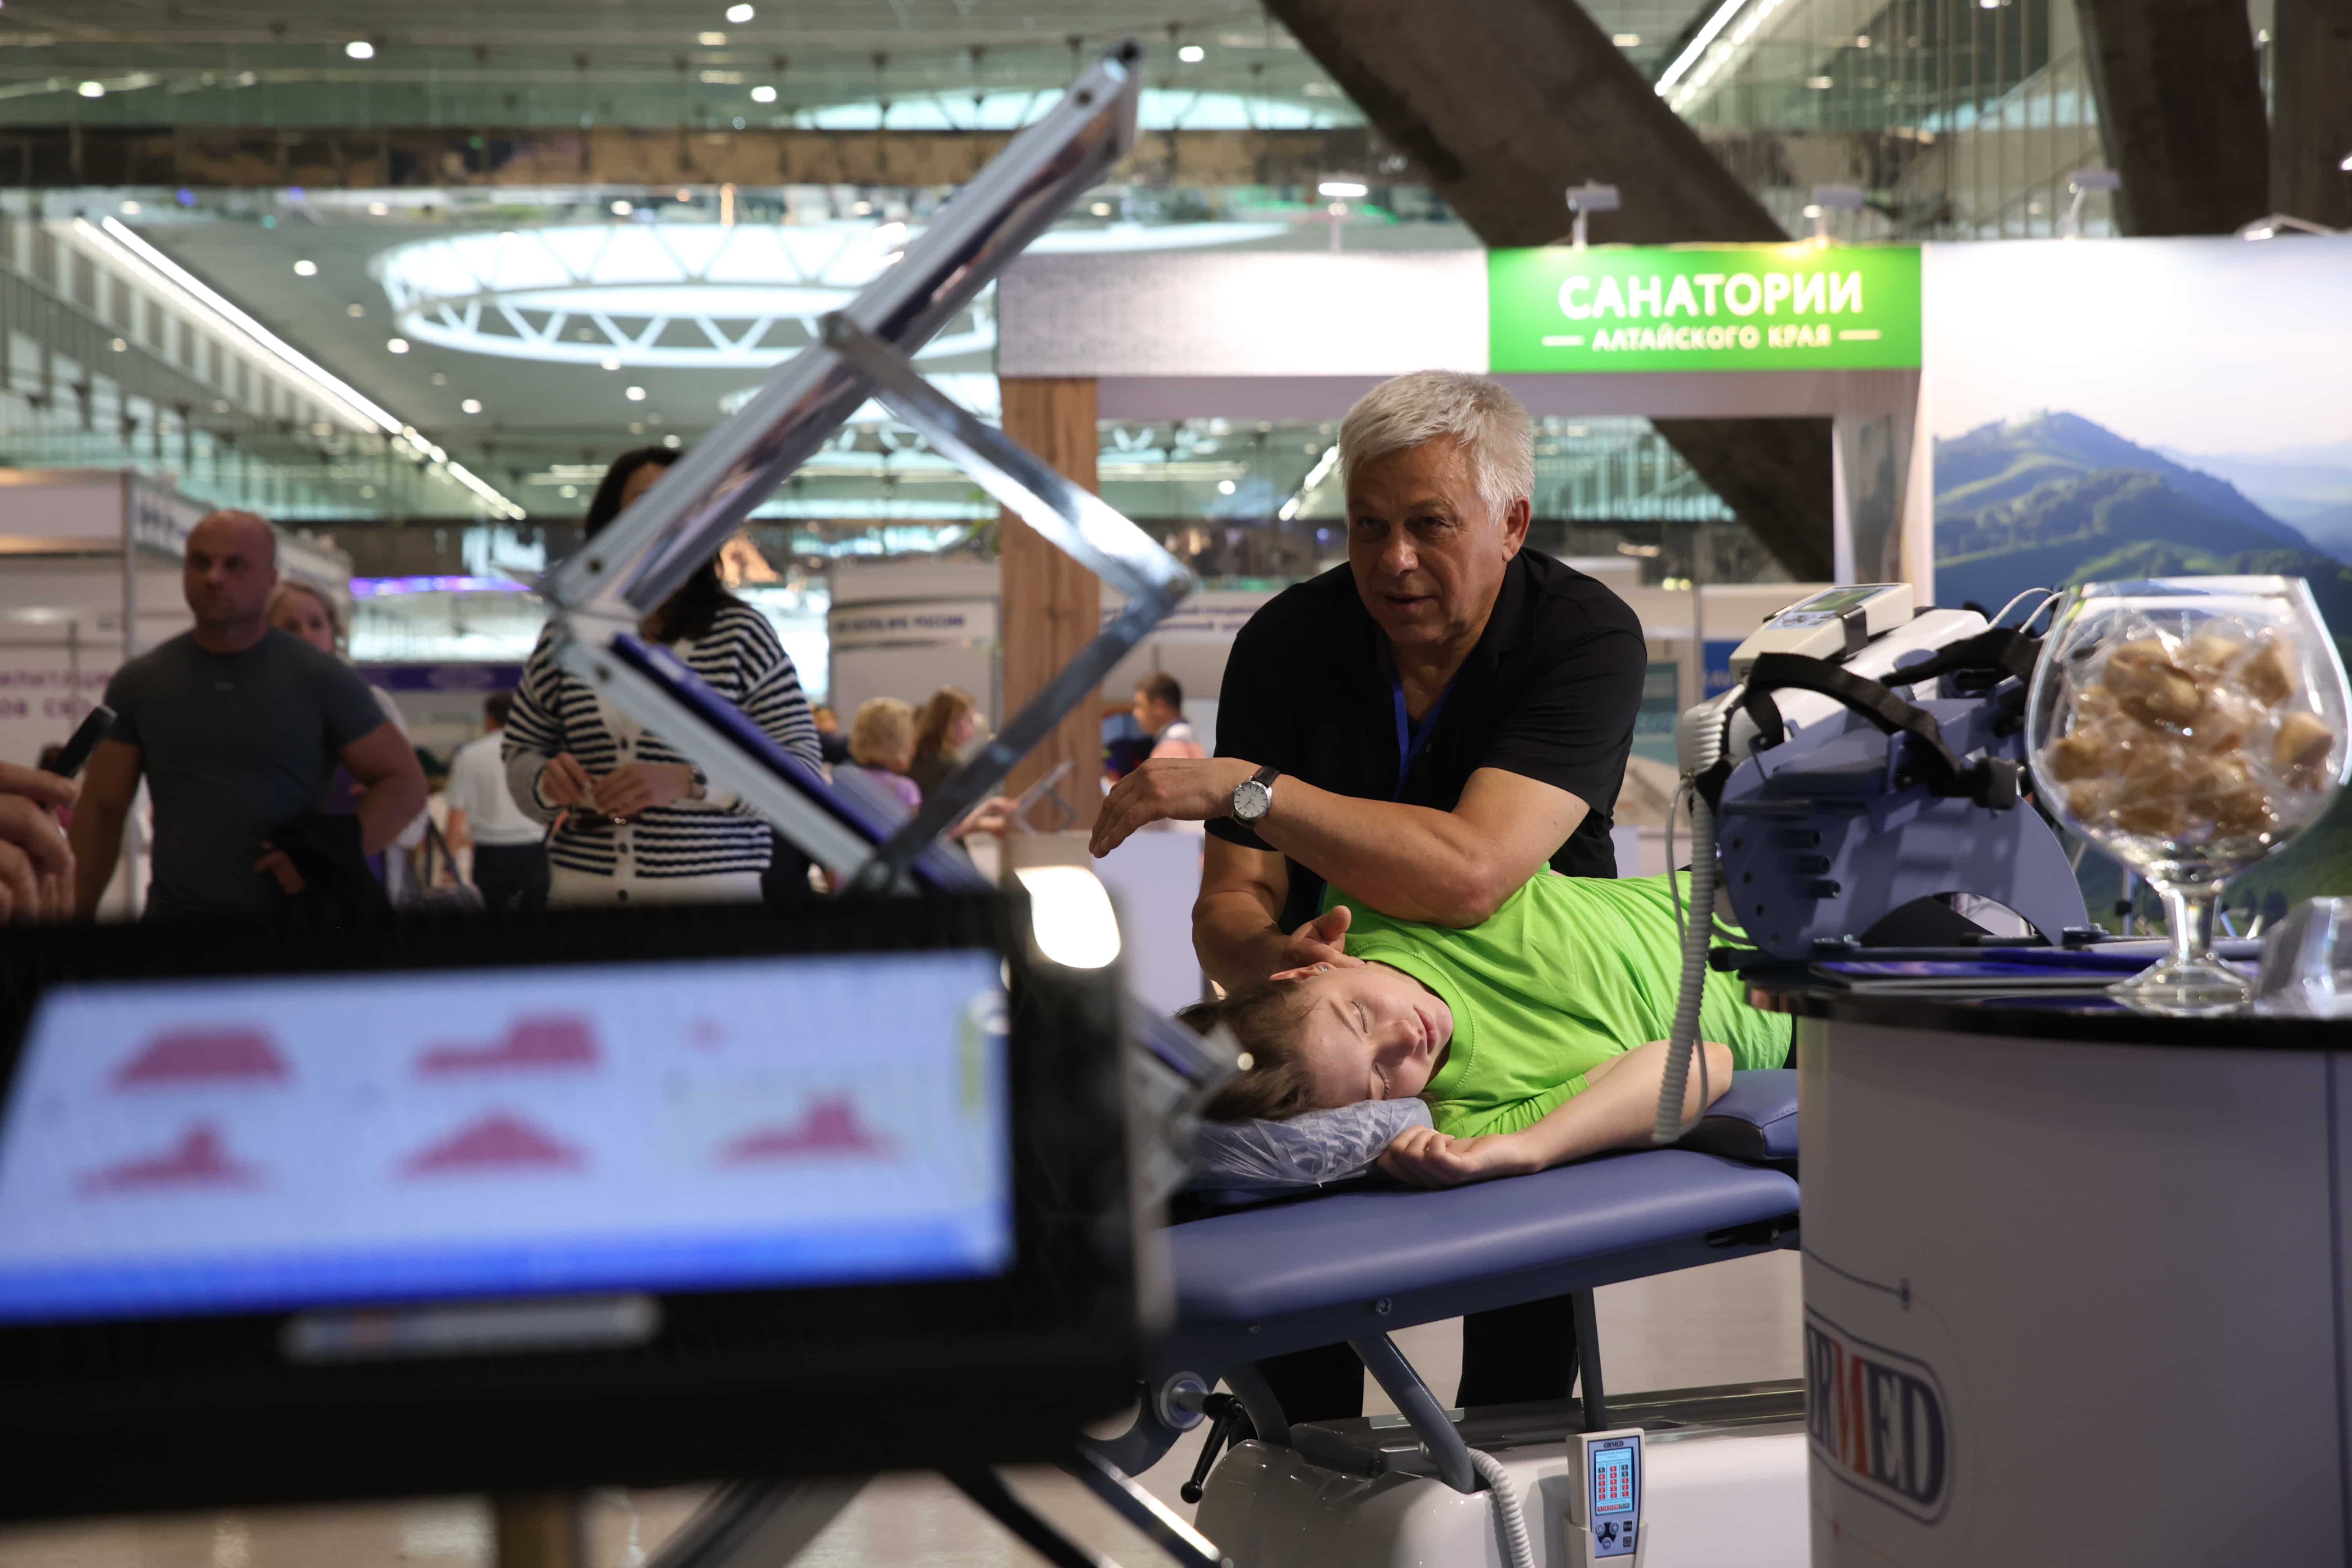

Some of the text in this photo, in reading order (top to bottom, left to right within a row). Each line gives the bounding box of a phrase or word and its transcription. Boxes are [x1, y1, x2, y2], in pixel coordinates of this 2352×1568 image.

[1558, 270, 1862, 319] САНАТОРИИ
[1592, 323, 1831, 351] АЛТАЙСКОГО КРАЯ
